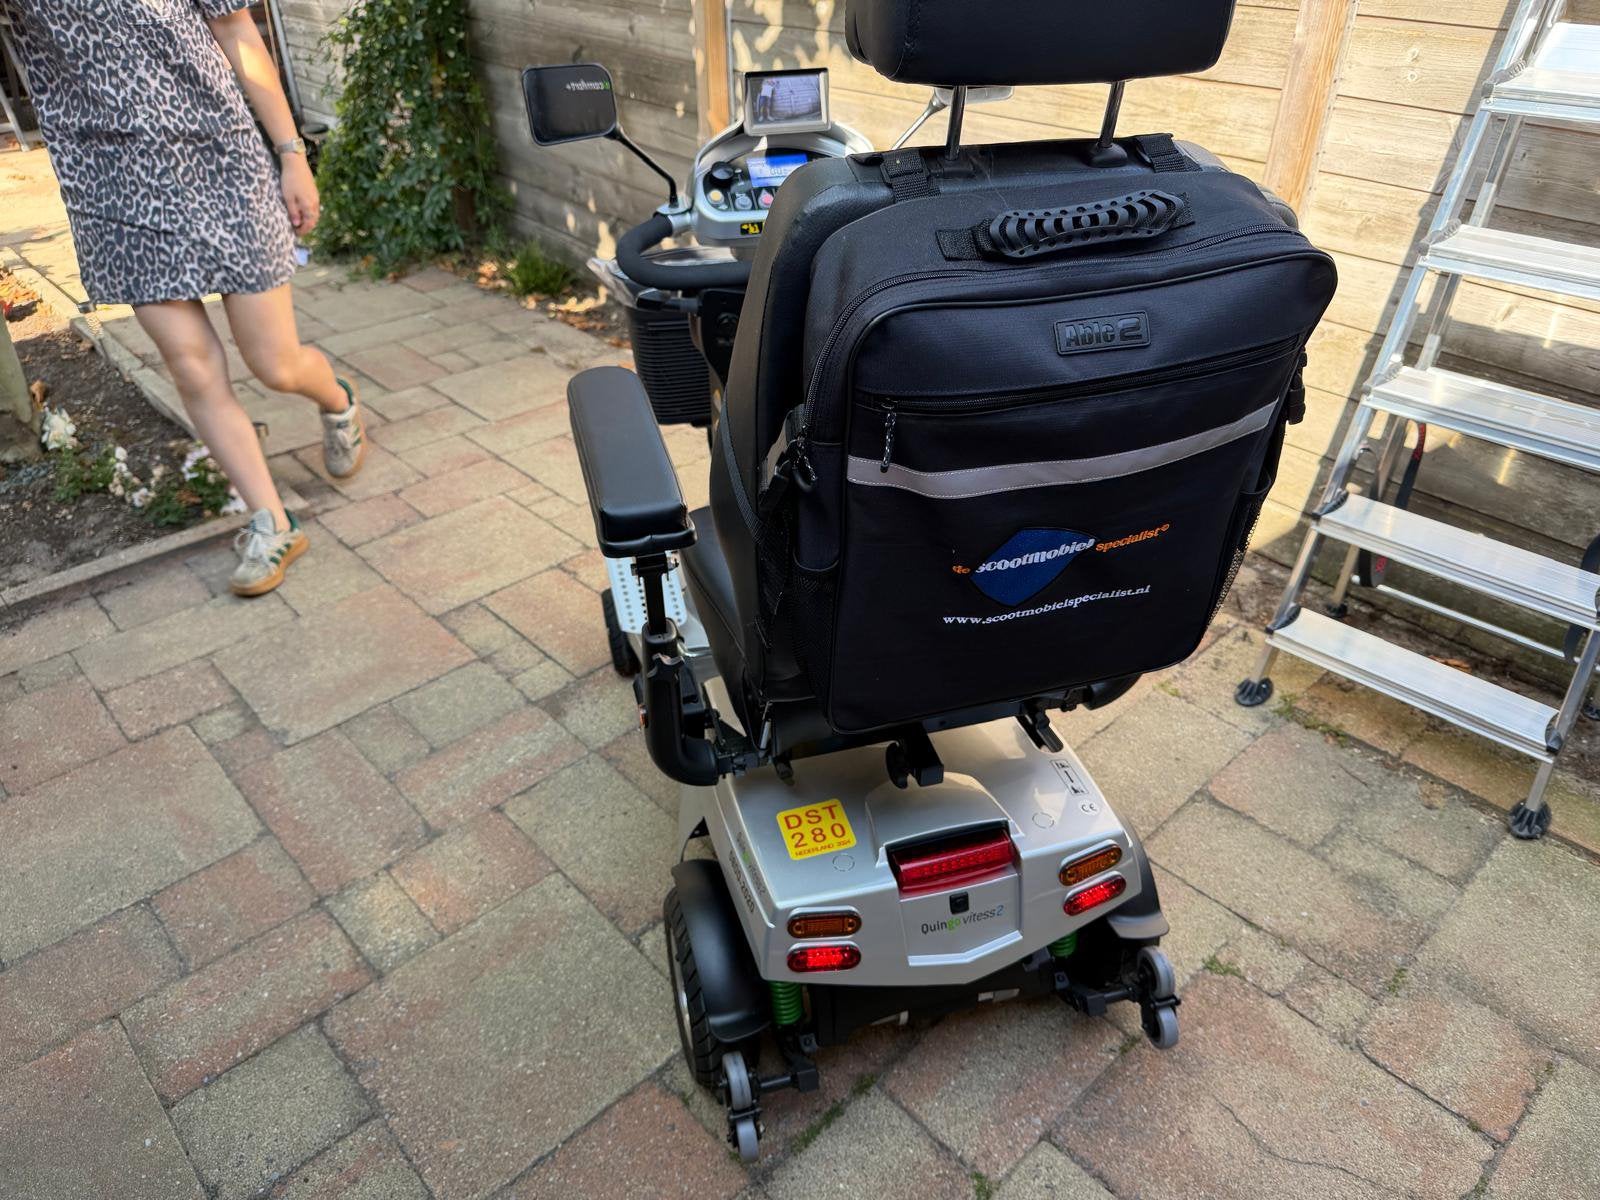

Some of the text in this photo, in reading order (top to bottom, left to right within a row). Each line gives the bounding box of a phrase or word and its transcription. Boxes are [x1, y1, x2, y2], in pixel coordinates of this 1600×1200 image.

[942, 584, 1151, 625] www.scootmobielspecialist.nl
[783, 804, 838, 830] DST
[791, 822, 846, 849] 280
[920, 918, 961, 935] Quingo
